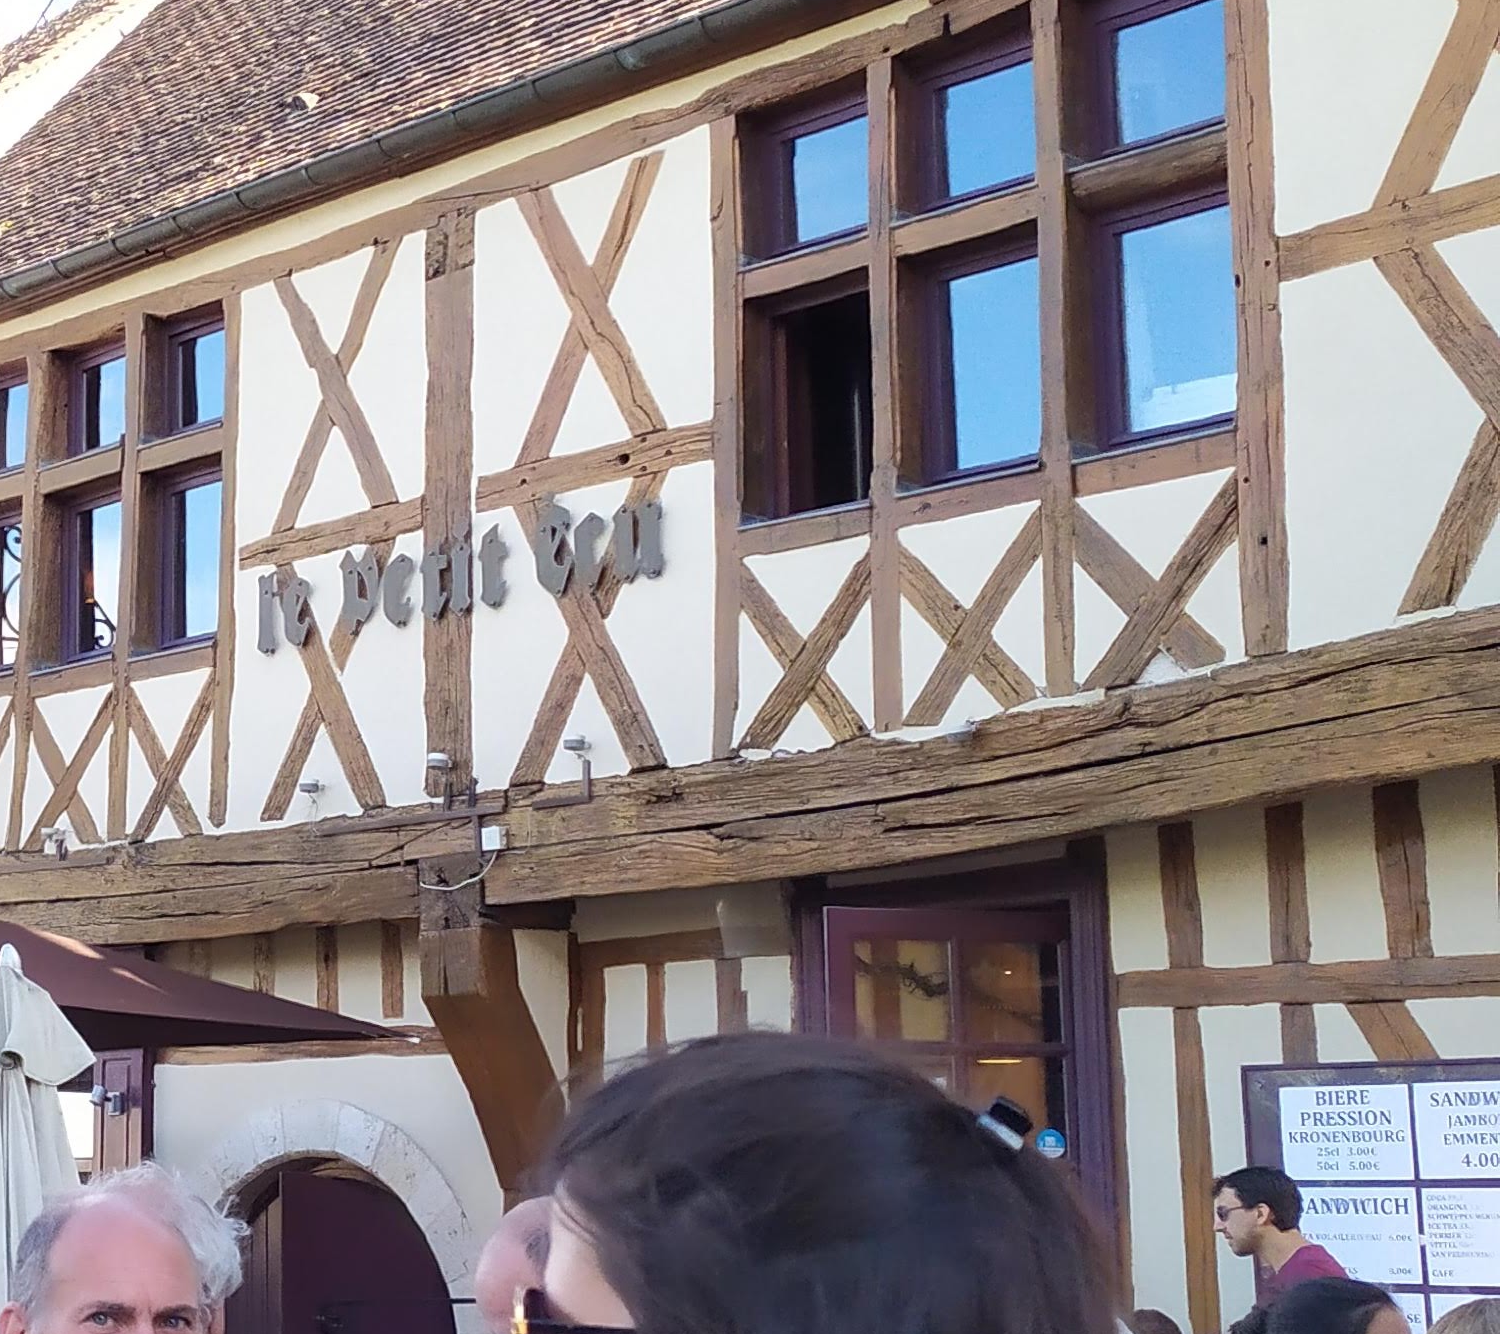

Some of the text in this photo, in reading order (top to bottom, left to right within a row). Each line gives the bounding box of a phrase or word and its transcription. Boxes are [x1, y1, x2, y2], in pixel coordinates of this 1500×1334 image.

[1315, 1089, 1370, 1106] BIERE
[1300, 1110, 1392, 1126] PRESSION
[1448, 1114, 1500, 1129] JAMBO
[1289, 1129, 1405, 1144] KRONENBOURG
[1444, 1133, 1500, 1145] EMMEN
[1461, 1153, 1500, 1168] 4.00
